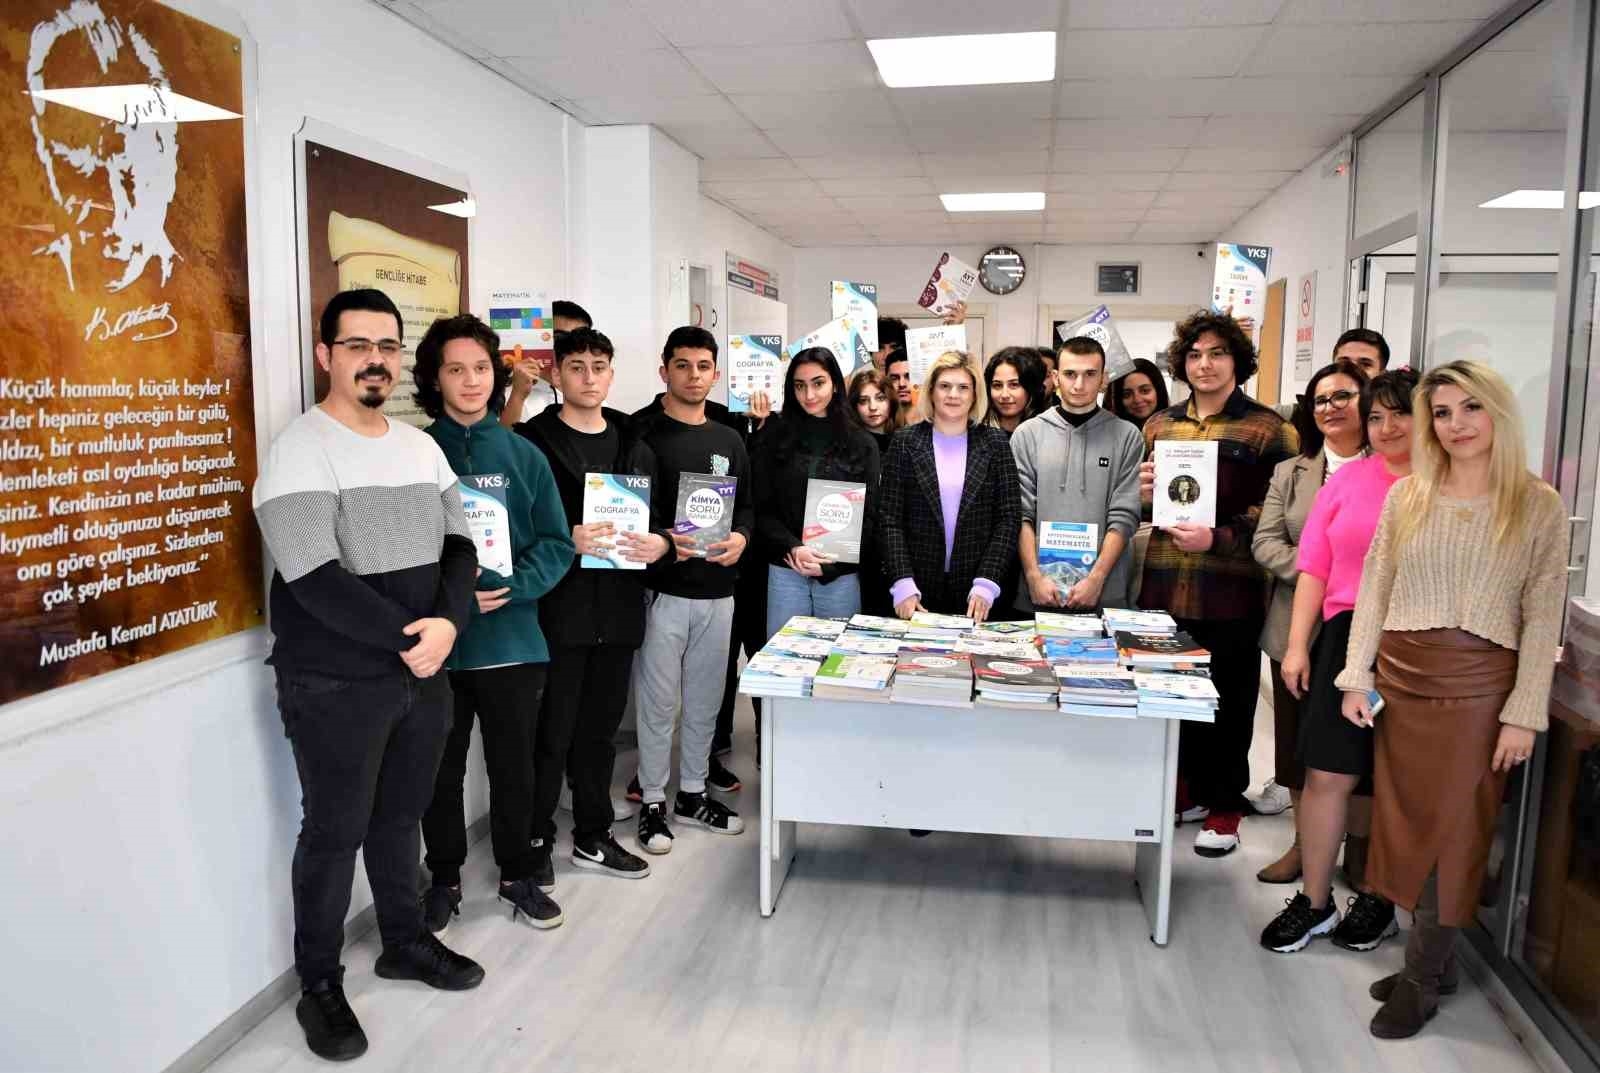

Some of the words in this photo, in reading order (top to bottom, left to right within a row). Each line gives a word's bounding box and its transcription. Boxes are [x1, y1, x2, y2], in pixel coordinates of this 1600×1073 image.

[1247, 247, 1267, 258] YKS
[760, 336, 781, 345] YKS
[0, 377, 56, 404] Küçük
[60, 377, 135, 400] hanımlar,
[138, 377, 180, 401] küçük
[38, 407, 100, 434] hepiniz
[103, 405, 174, 430] geleceğin
[176, 403, 196, 422] bir
[198, 402, 230, 425] gülü,
[49, 436, 74, 458] bir
[78, 431, 145, 455] mutluluk
[82, 461, 110, 484] asıl
[113, 456, 179, 485] aydınlığa
[182, 450, 236, 474] boğacak
[475, 475, 503, 489] YKS
[625, 477, 649, 488] YKS
[718, 486, 735, 495] TYT
[48, 489, 131, 518] Kendinizin
[135, 489, 154, 505] ne
[157, 480, 198, 502] kadar
[199, 475, 245, 497] mühim,
[689, 504, 721, 514] SORU
[0, 523, 69, 558] kıymetli
[72, 515, 163, 543] olduğunuzu
[166, 500, 232, 528] düşünerek
[16, 562, 52, 582] ona
[56, 551, 96, 579] göre
[99, 541, 161, 571] çalışınız.
[165, 527, 224, 553] Sizlerden
[42, 581, 74, 611] çok
[77, 574, 124, 604] şeyler
[39, 631, 108, 667] Mustafa
[111, 620, 157, 646] Kemal
[159, 600, 218, 632] ATATÜRK
